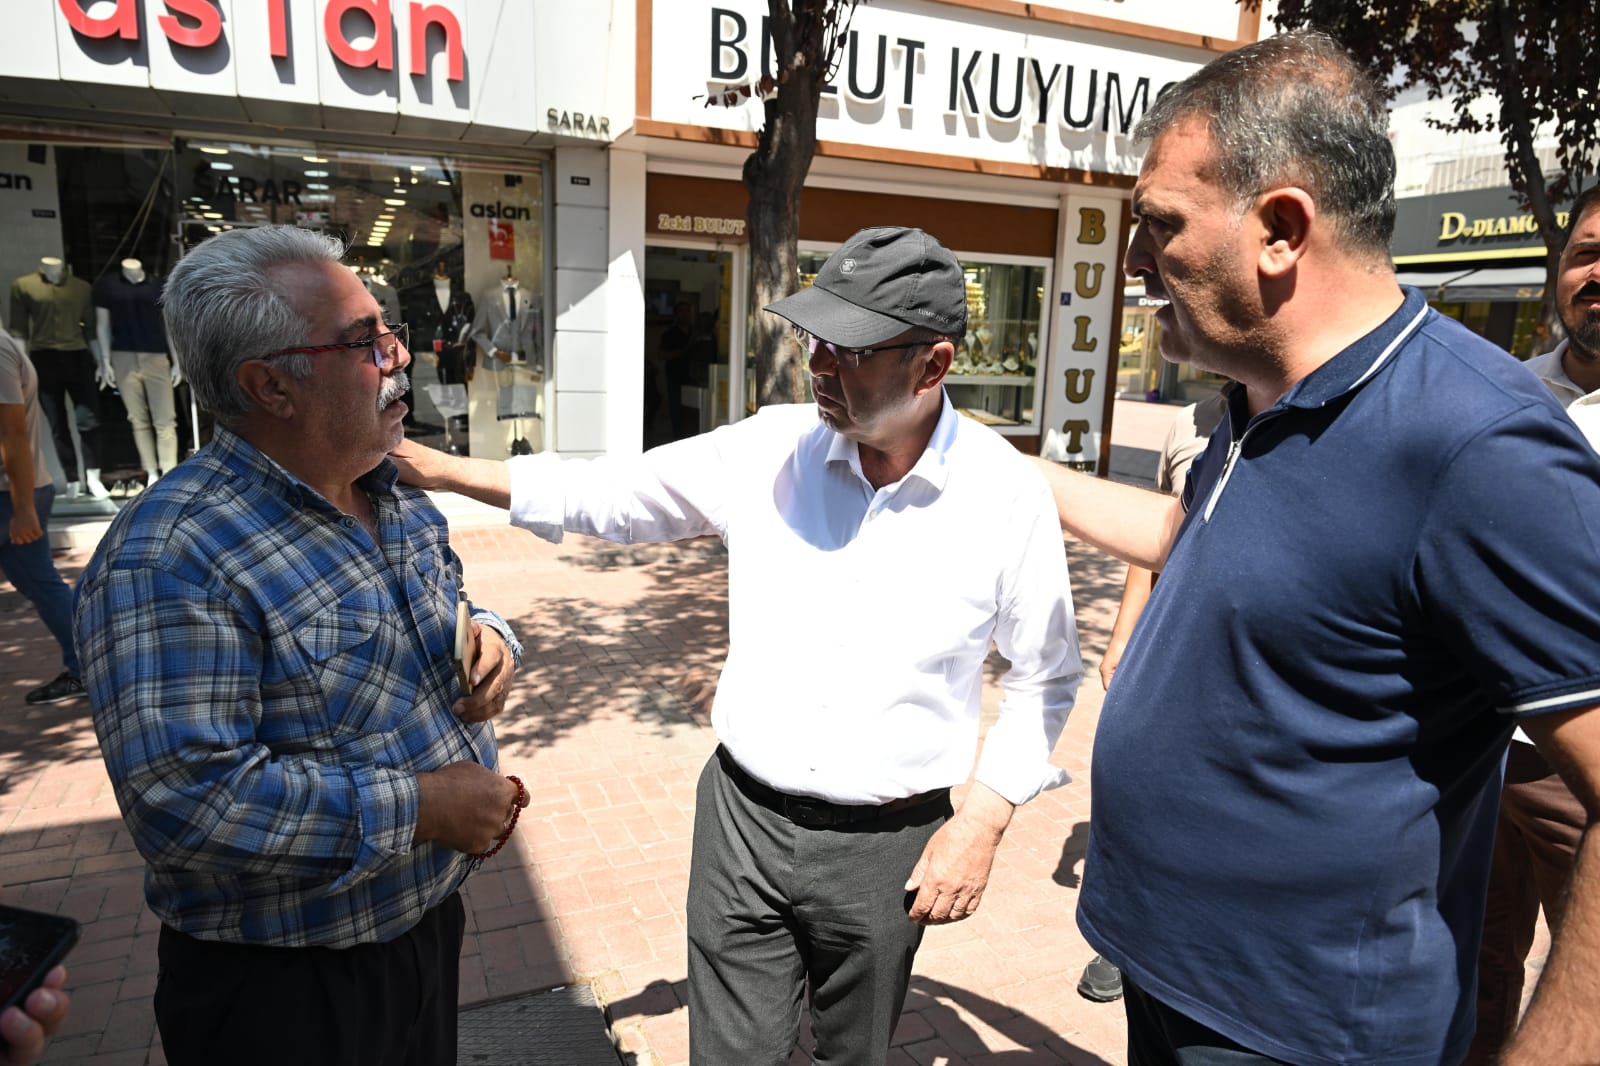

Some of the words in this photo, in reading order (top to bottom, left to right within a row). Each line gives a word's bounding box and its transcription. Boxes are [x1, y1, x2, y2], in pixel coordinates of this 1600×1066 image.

[58, 0, 464, 82] aslan
[711, 7, 925, 105] BUT
[949, 46, 1178, 134] KUYUM
[547, 107, 610, 135] SARAR
[470, 201, 531, 221] aslan
[658, 214, 692, 232] Zeki
[694, 216, 746, 236] BULUT
[1062, 206, 1106, 454] BULUT
